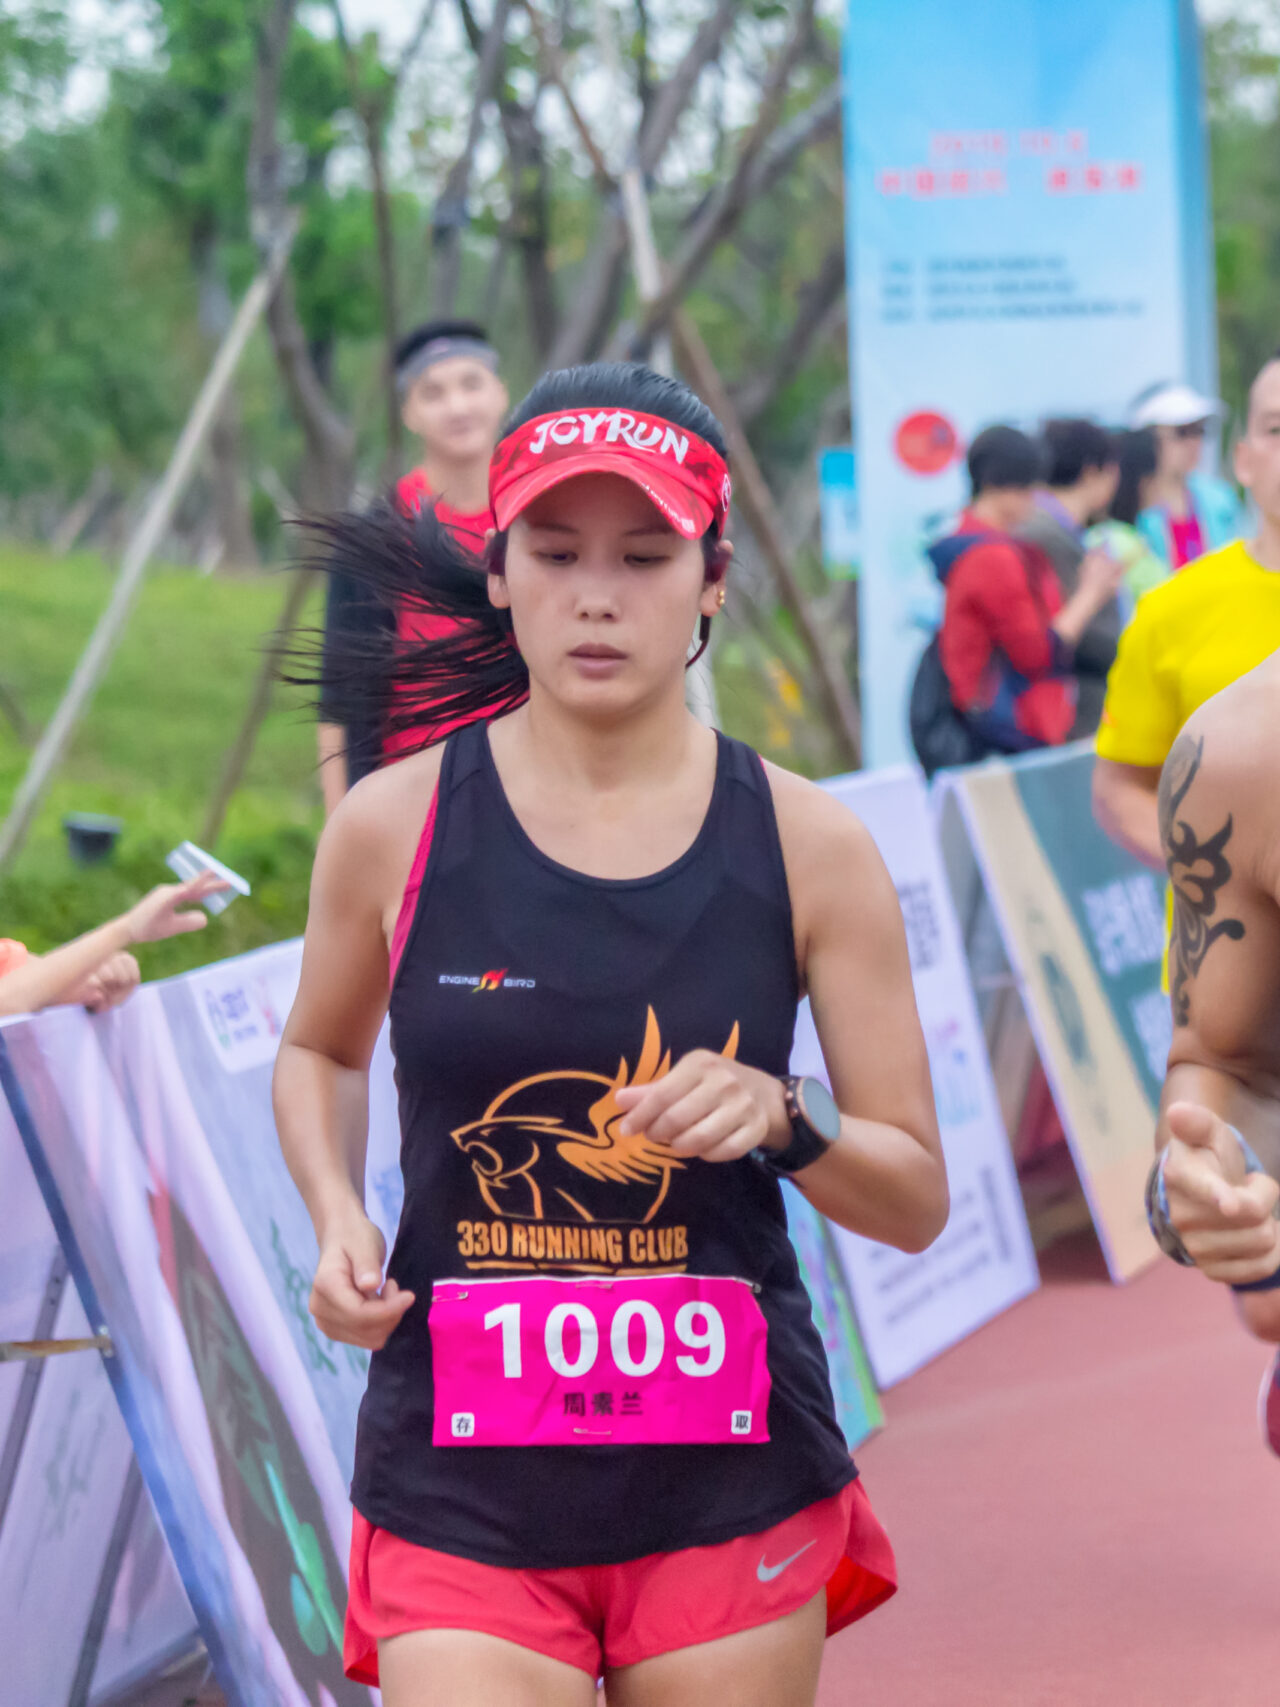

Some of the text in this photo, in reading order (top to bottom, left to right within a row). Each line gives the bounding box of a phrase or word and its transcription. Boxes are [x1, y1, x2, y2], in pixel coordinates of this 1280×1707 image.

[529, 411, 689, 464] JOYRUN
[438, 974, 536, 988] ENGINE BIRD
[456, 1220, 690, 1264] 330 RUNNING CLUB
[484, 1299, 726, 1379] 1009
[562, 1391, 644, 1417] 周素兰
